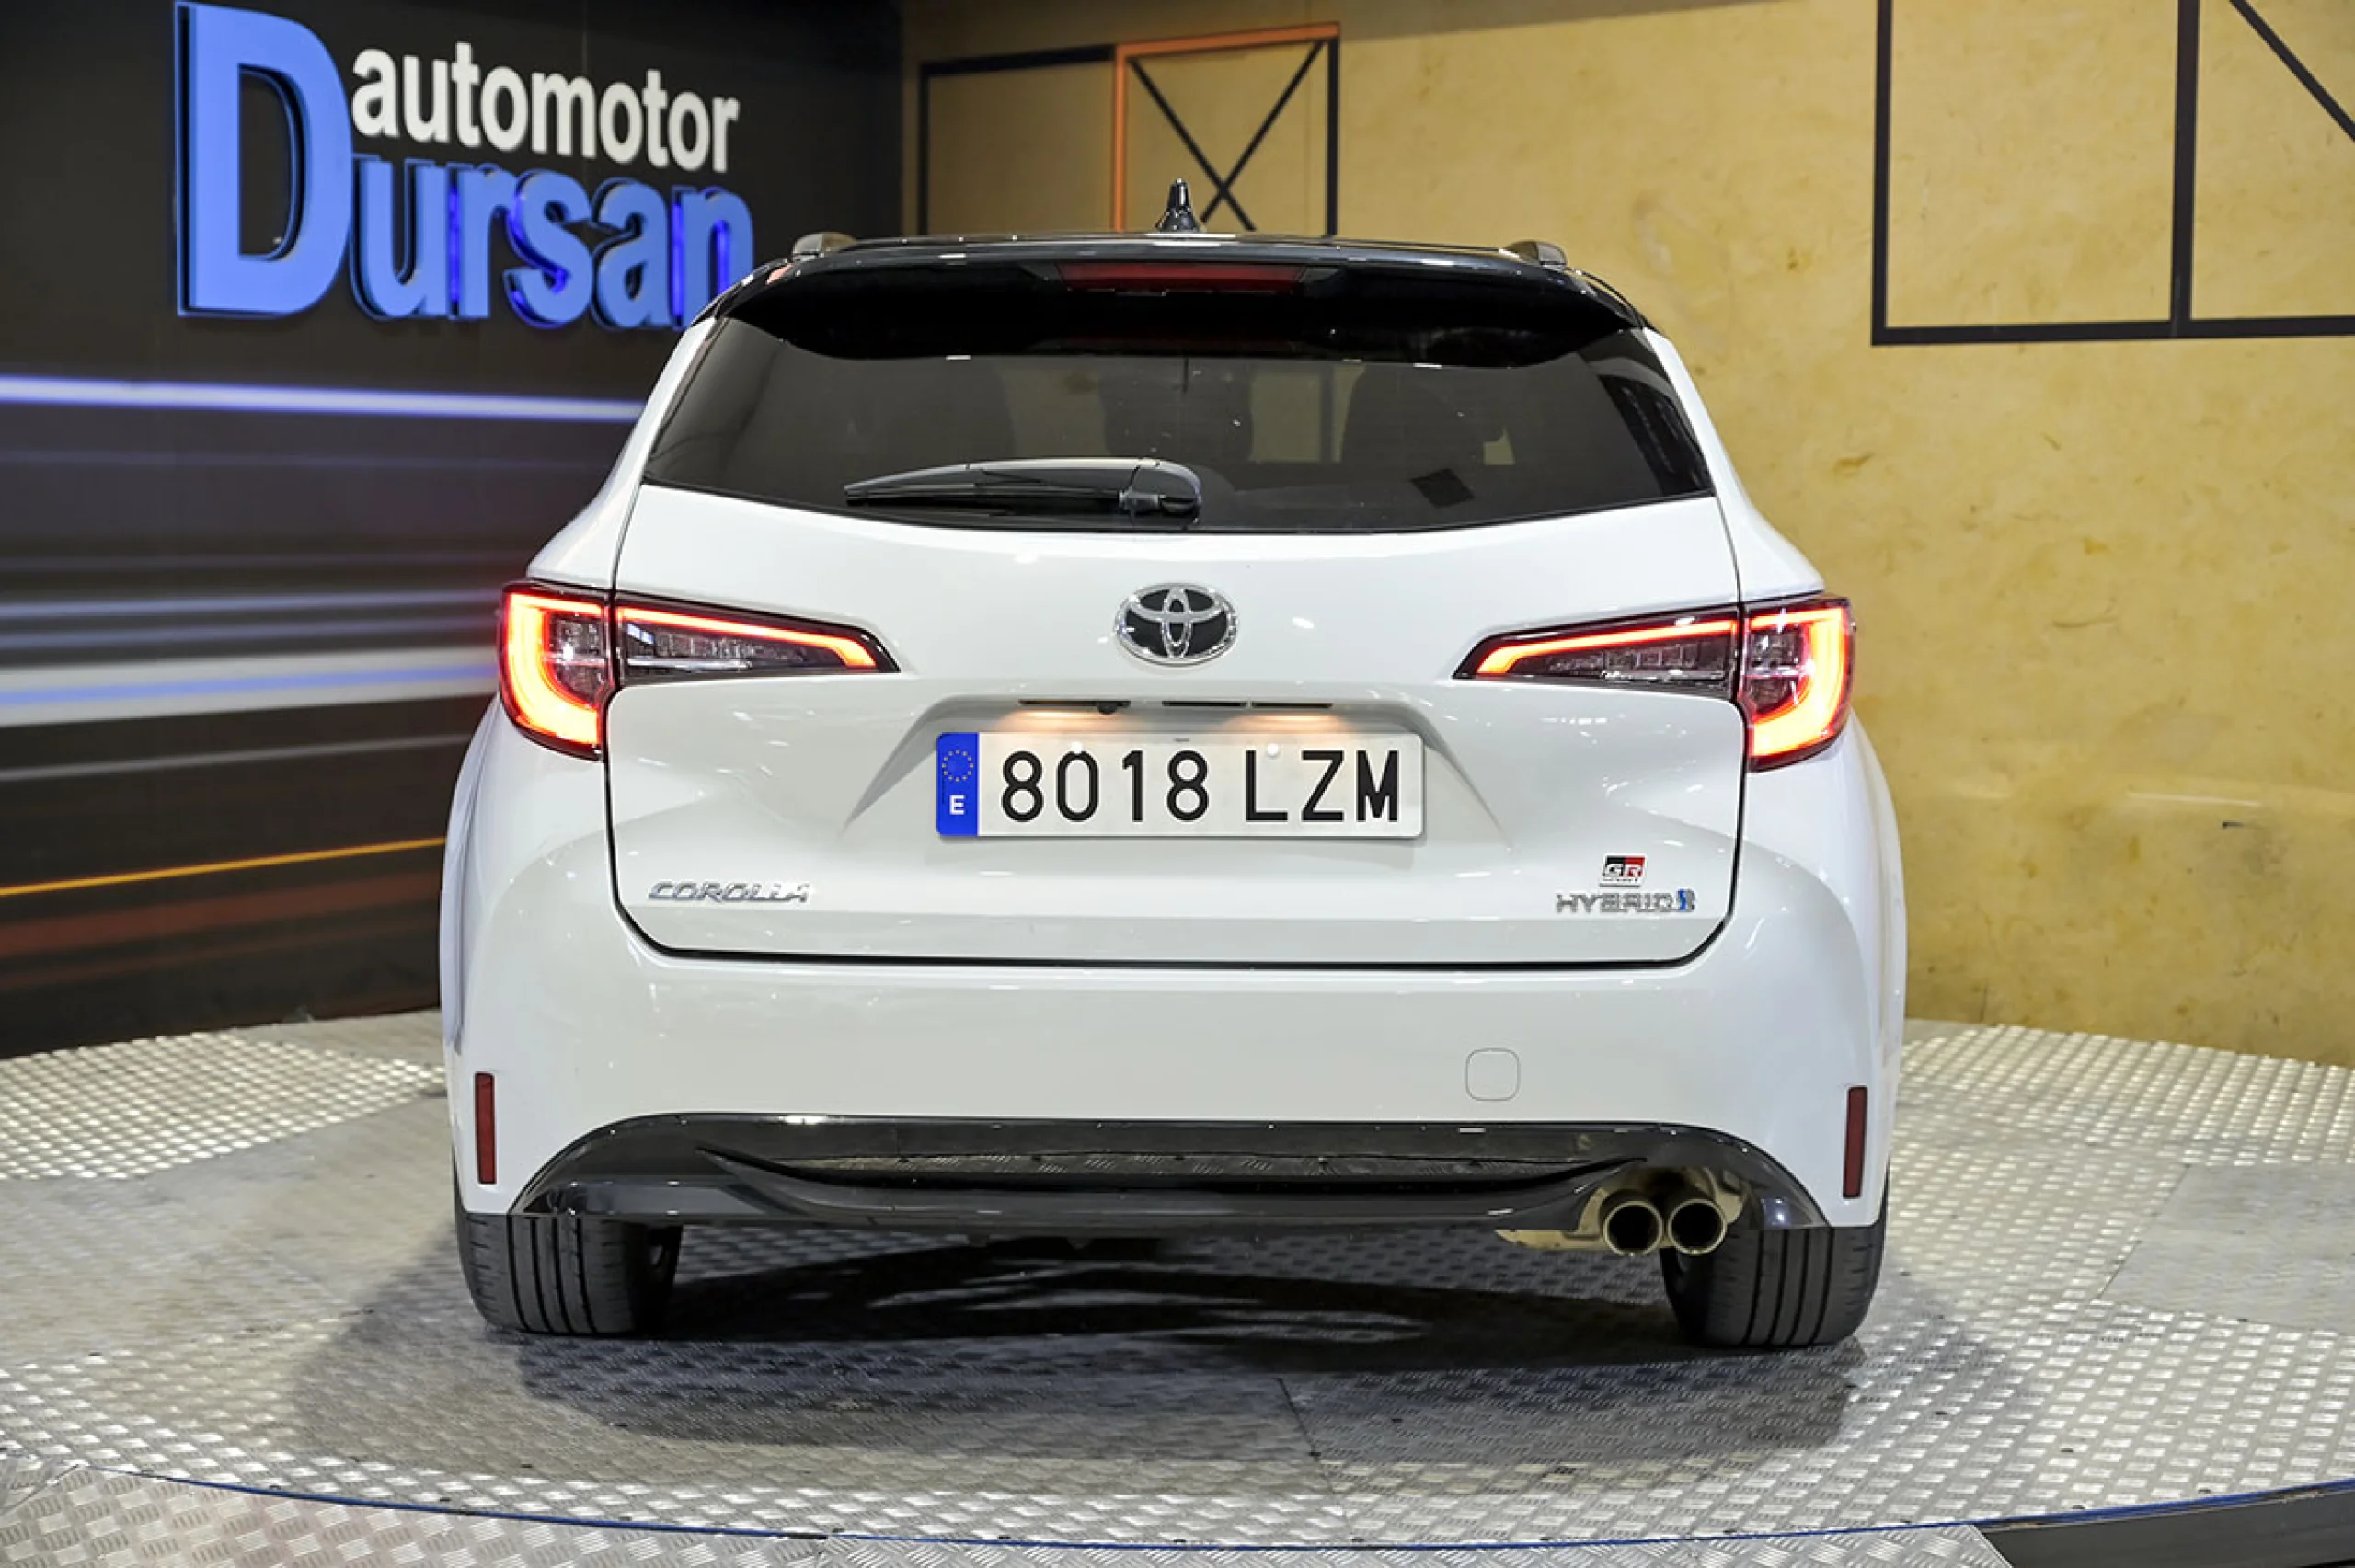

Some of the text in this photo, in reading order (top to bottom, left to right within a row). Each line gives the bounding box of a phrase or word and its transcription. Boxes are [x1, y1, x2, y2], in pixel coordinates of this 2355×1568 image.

[351, 42, 740, 173] automotor
[175, 0, 754, 331] Dursan
[1001, 750, 1210, 823] 8018
[1245, 749, 1398, 822] LZM
[949, 794, 966, 816] E
[1603, 860, 1645, 878] GR
[649, 881, 810, 903] COROLLA
[1556, 892, 1676, 913] HYBRID
